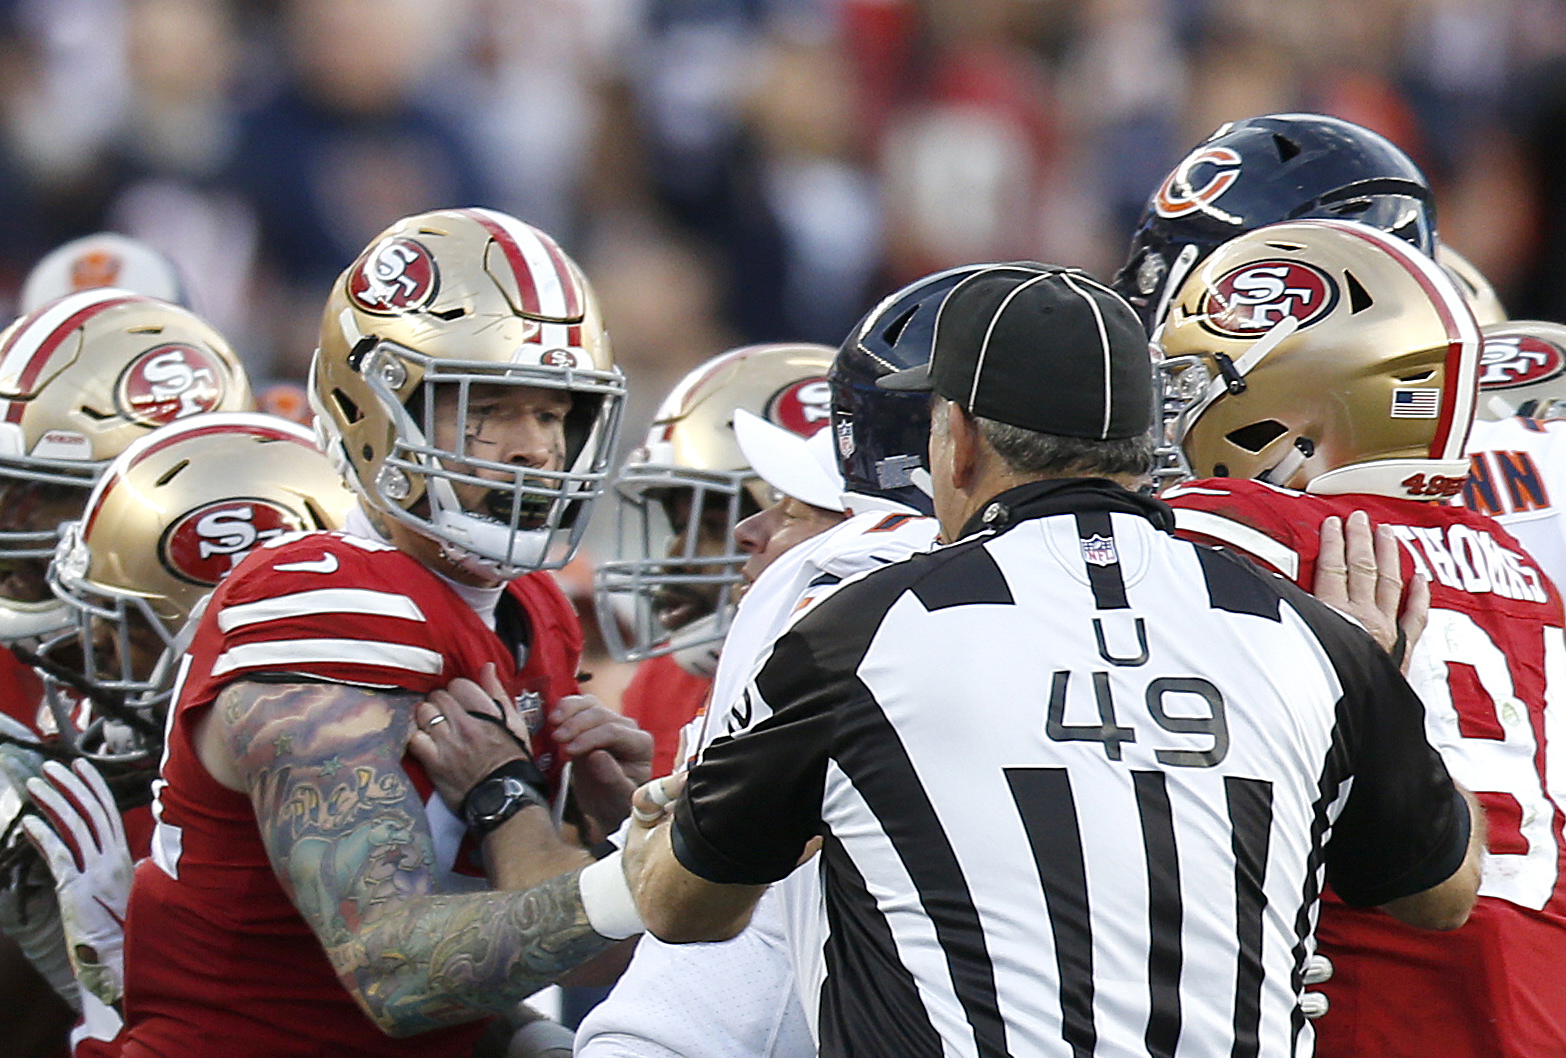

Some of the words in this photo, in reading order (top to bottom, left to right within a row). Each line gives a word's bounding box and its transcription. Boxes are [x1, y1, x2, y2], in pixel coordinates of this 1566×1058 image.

[1229, 267, 1313, 329] SF
[1091, 617, 1150, 667] U
[1045, 670, 1230, 769] 49
[1407, 607, 1566, 912] 9
